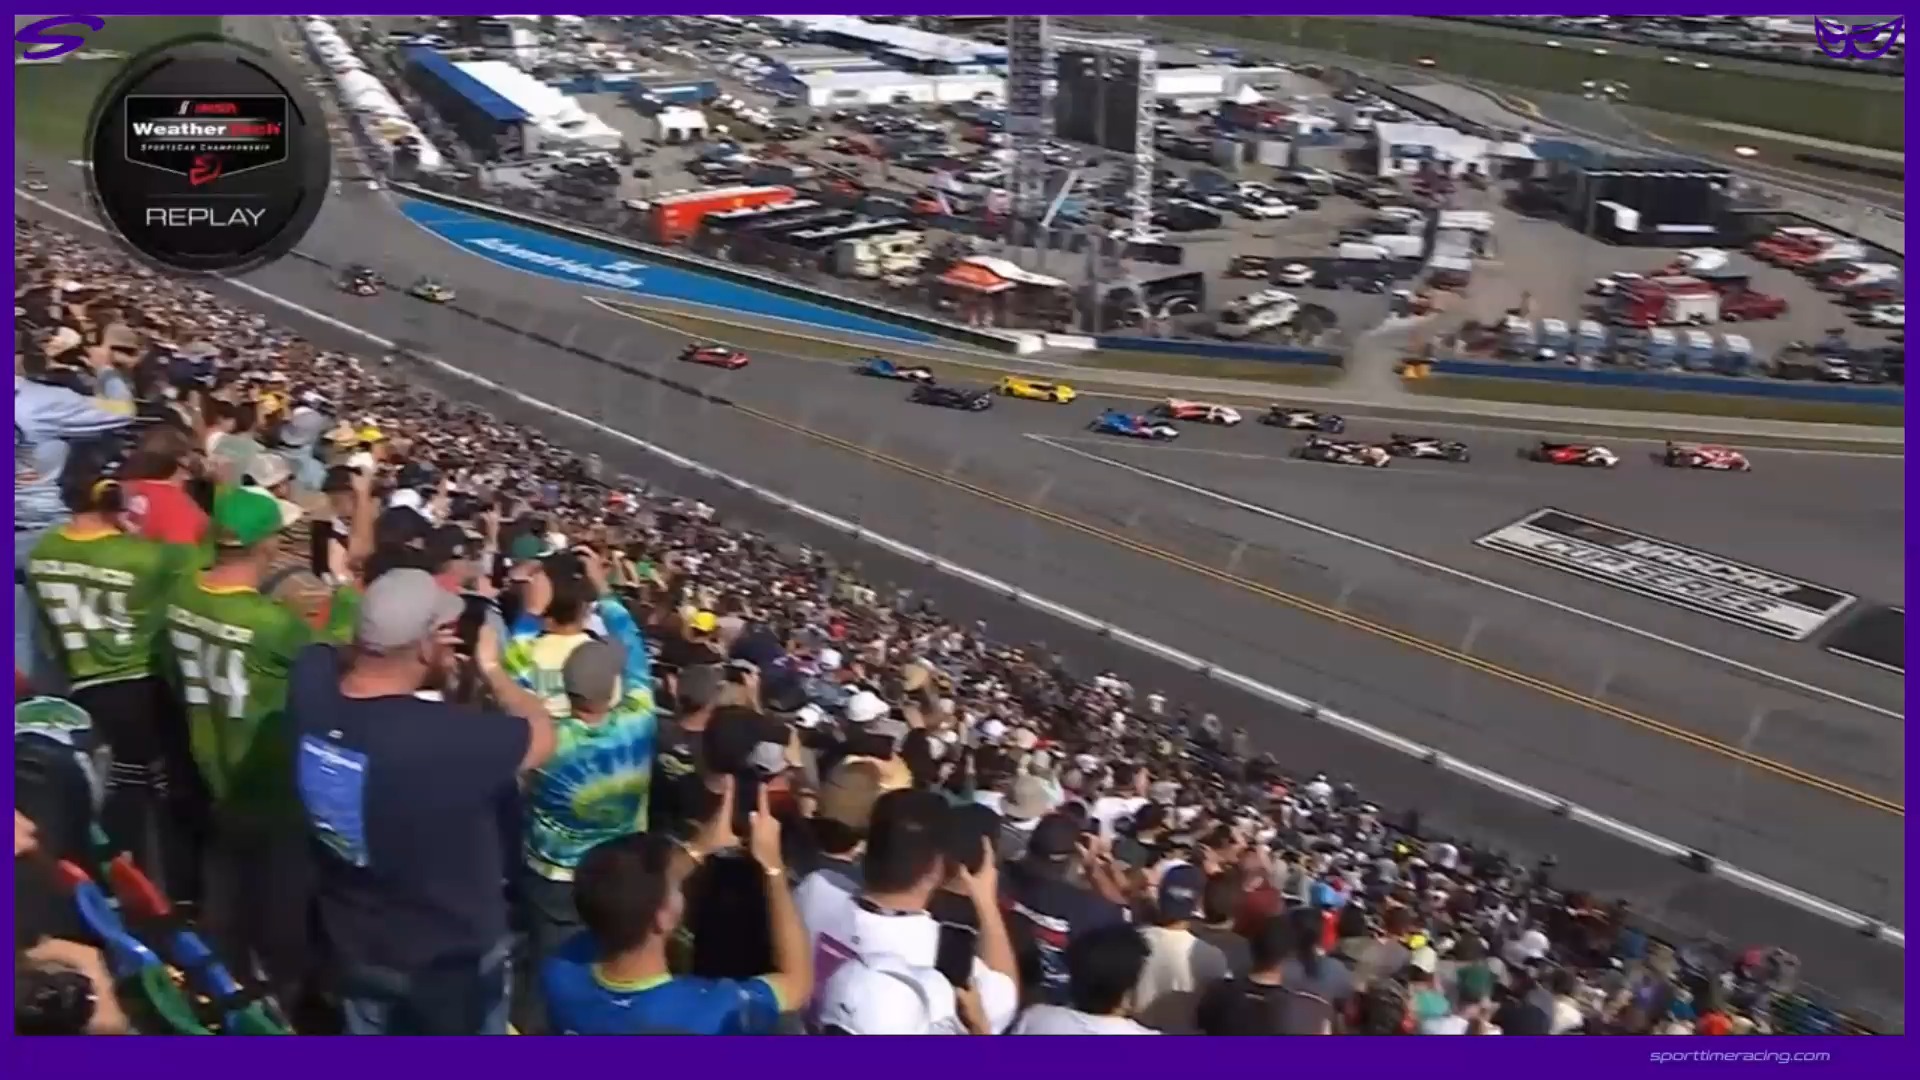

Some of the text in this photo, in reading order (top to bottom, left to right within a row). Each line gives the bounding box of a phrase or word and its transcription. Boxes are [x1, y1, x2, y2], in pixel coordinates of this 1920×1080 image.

[1532, 536, 1780, 615] CUP SERIES
[1612, 537, 1802, 598] NASCAR
[169, 630, 249, 719] 24
